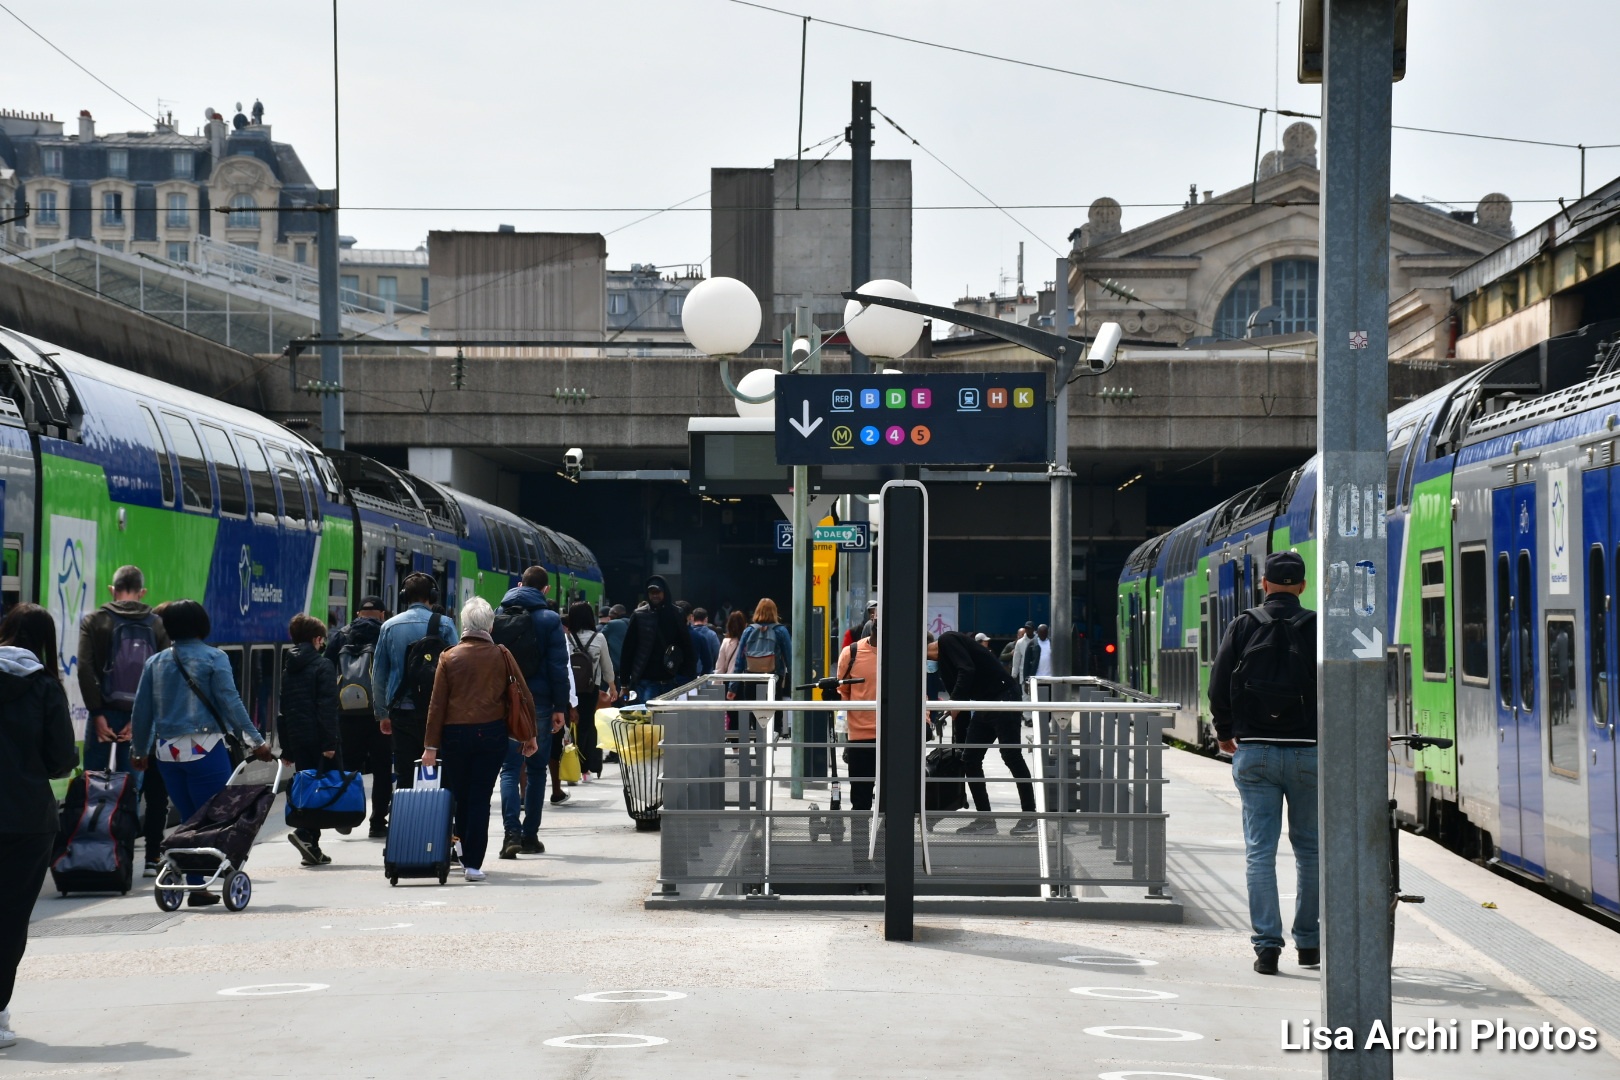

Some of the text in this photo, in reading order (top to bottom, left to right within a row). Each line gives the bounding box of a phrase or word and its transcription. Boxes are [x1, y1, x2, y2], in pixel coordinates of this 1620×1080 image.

[835, 395, 850, 403] RER
[866, 393, 875, 404] B
[891, 393, 902, 404] D
[992, 393, 1002, 404] H
[1019, 392, 1029, 404] K
[866, 430, 874, 441] 2
[890, 430, 899, 441] 4
[917, 430, 925, 441] 5
[782, 533, 794, 547] 2
[1328, 559, 1376, 617] 20
